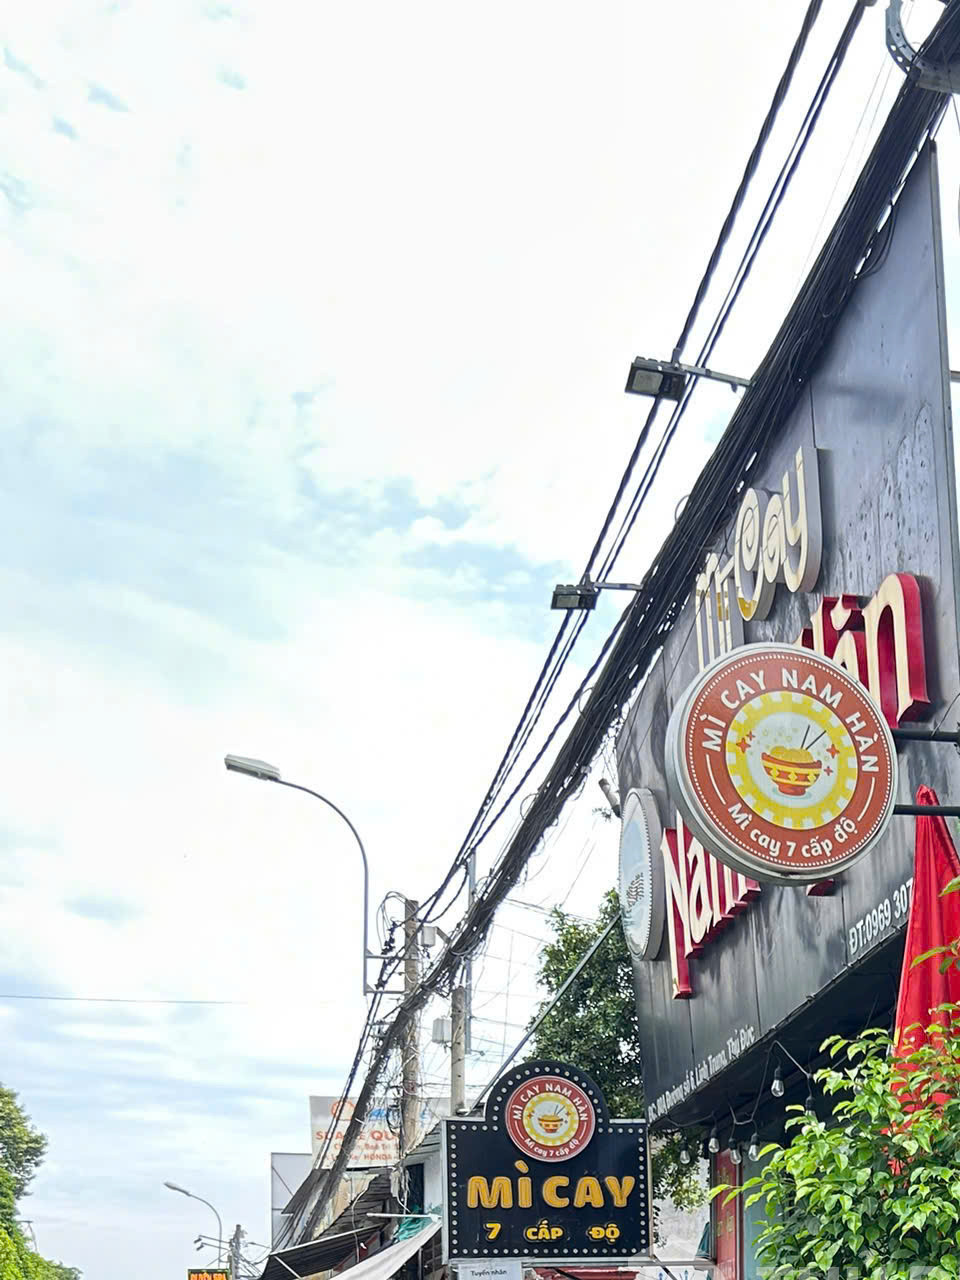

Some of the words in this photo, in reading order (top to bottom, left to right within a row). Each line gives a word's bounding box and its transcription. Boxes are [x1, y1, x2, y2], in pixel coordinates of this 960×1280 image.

[700, 713, 726, 751] MÌ
[720, 669, 767, 709] CAY
[782, 668, 843, 708] NAM
[845, 712, 880, 772] HÀN
[728, 803, 753, 831] Mì
[750, 828, 780, 857] cay
[786, 841, 796, 857] 7
[802, 835, 833, 858] cấp
[834, 816, 858, 844] độ
[512, 1104, 523, 1120] MÌ
[520, 1085, 540, 1103] CAY
[545, 1083, 572, 1097] NAM
[573, 1097, 588, 1120] HÀN
[534, 1146, 548, 1156] cay
[467, 1159, 533, 1209] MÌ
[542, 1176, 635, 1208] CAY
[484, 1223, 501, 1240] 7
[525, 1219, 564, 1241] CẤP
[588, 1223, 620, 1243] ĐỘ
